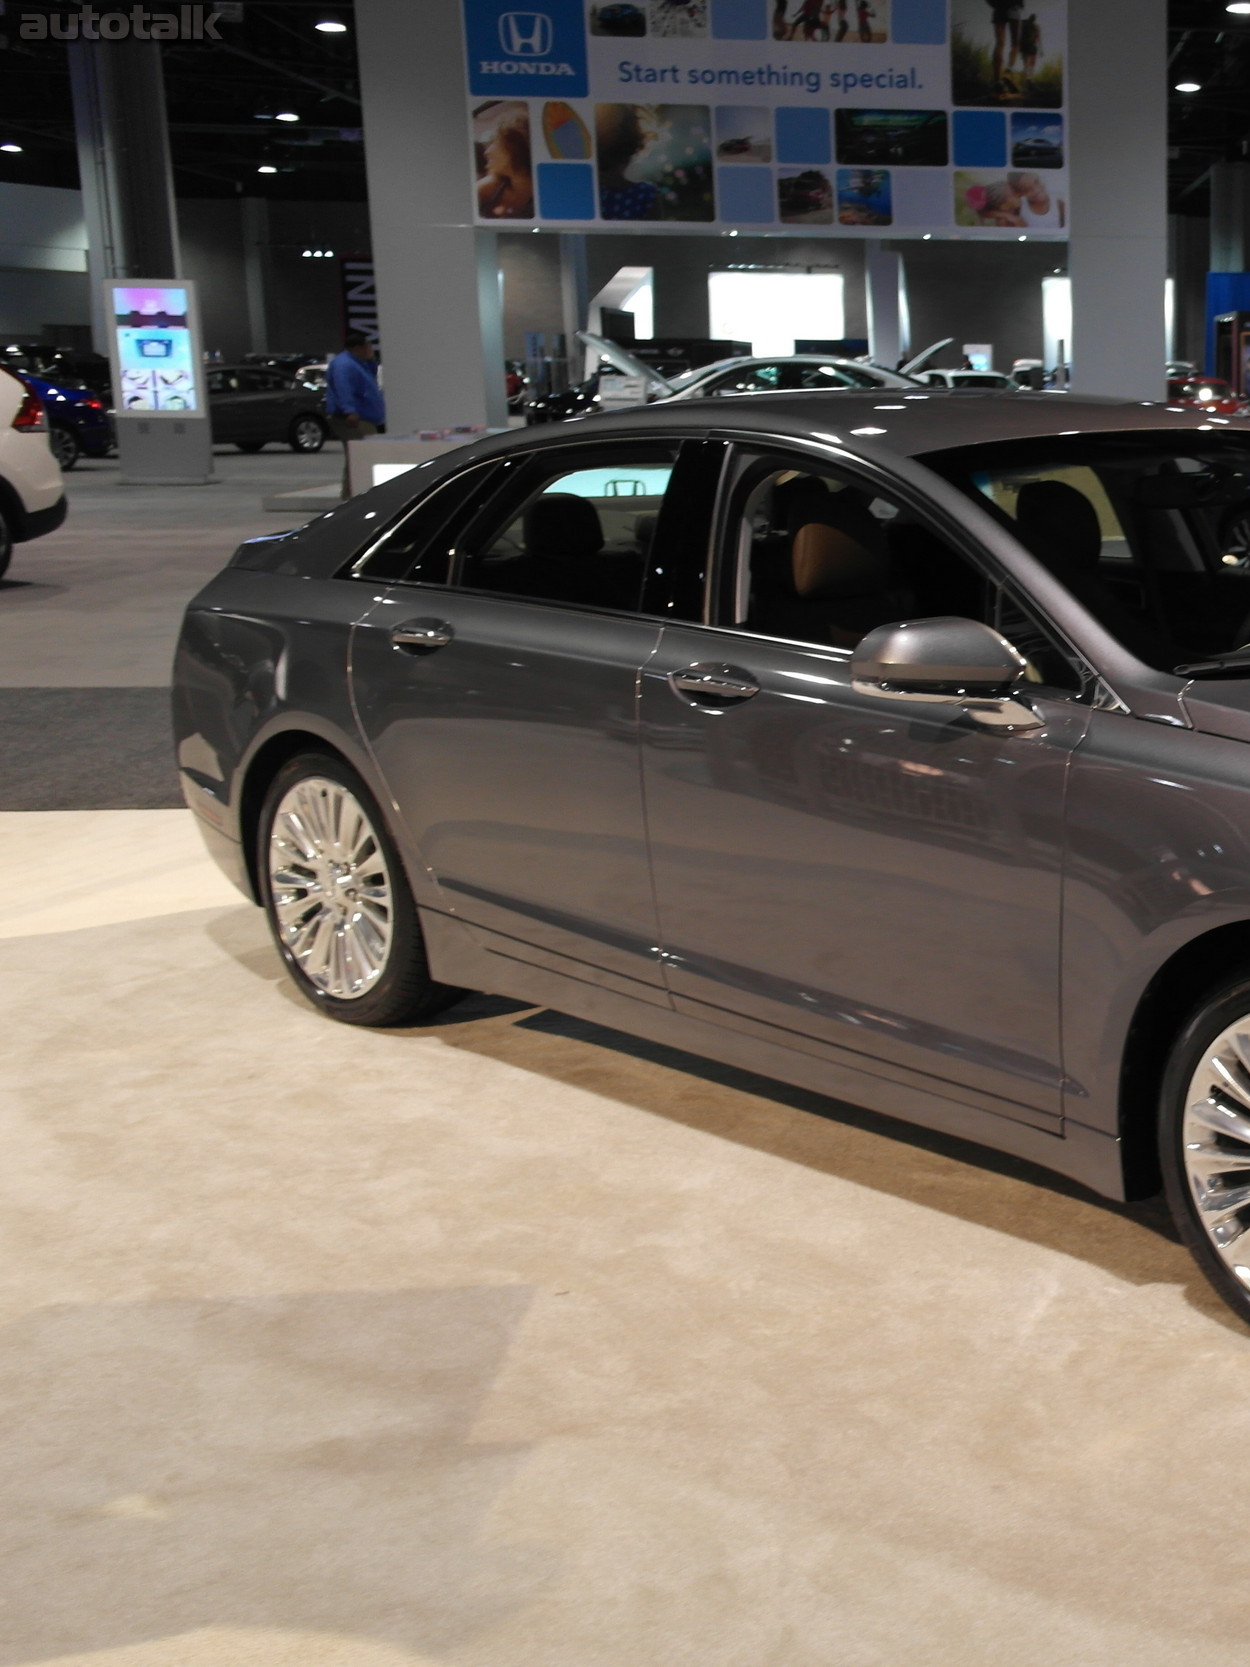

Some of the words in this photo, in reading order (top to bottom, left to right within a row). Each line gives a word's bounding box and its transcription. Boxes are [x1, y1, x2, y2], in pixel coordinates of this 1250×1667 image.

[480, 61, 575, 75] HONDA
[618, 61, 679, 83] Start
[688, 65, 821, 93] something
[830, 68, 923, 93] special.
